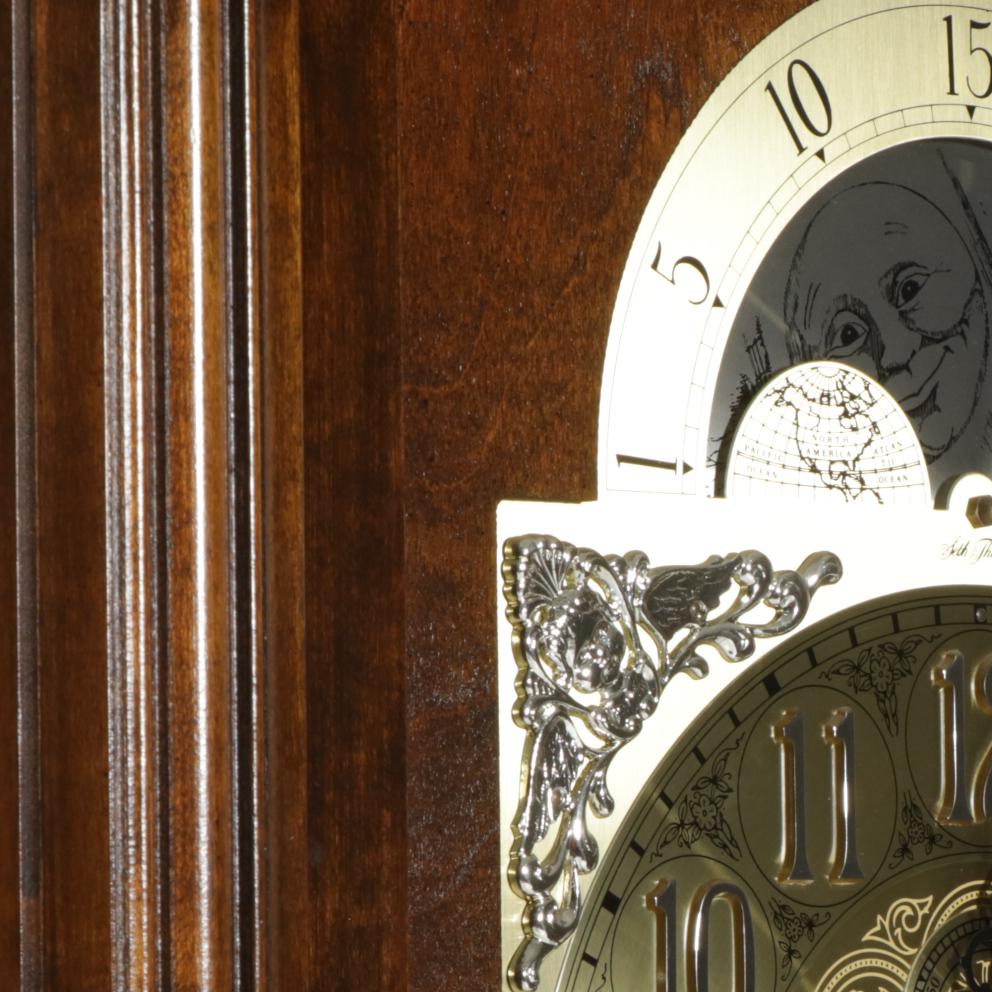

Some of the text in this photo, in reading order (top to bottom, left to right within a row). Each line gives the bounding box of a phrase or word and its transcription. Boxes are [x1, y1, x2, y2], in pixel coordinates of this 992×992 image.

[764, 58, 833, 157] 10
[650, 240, 710, 306] 5
[812, 434, 849, 444] NORTH
[744, 445, 784, 462] PACIFIC
[805, 448, 851, 458] AMERICA
[615, 453, 679, 476] 1
[746, 465, 778, 479] OCEAN
[878, 475, 909, 484] OCEAN
[768, 704, 865, 887] 11
